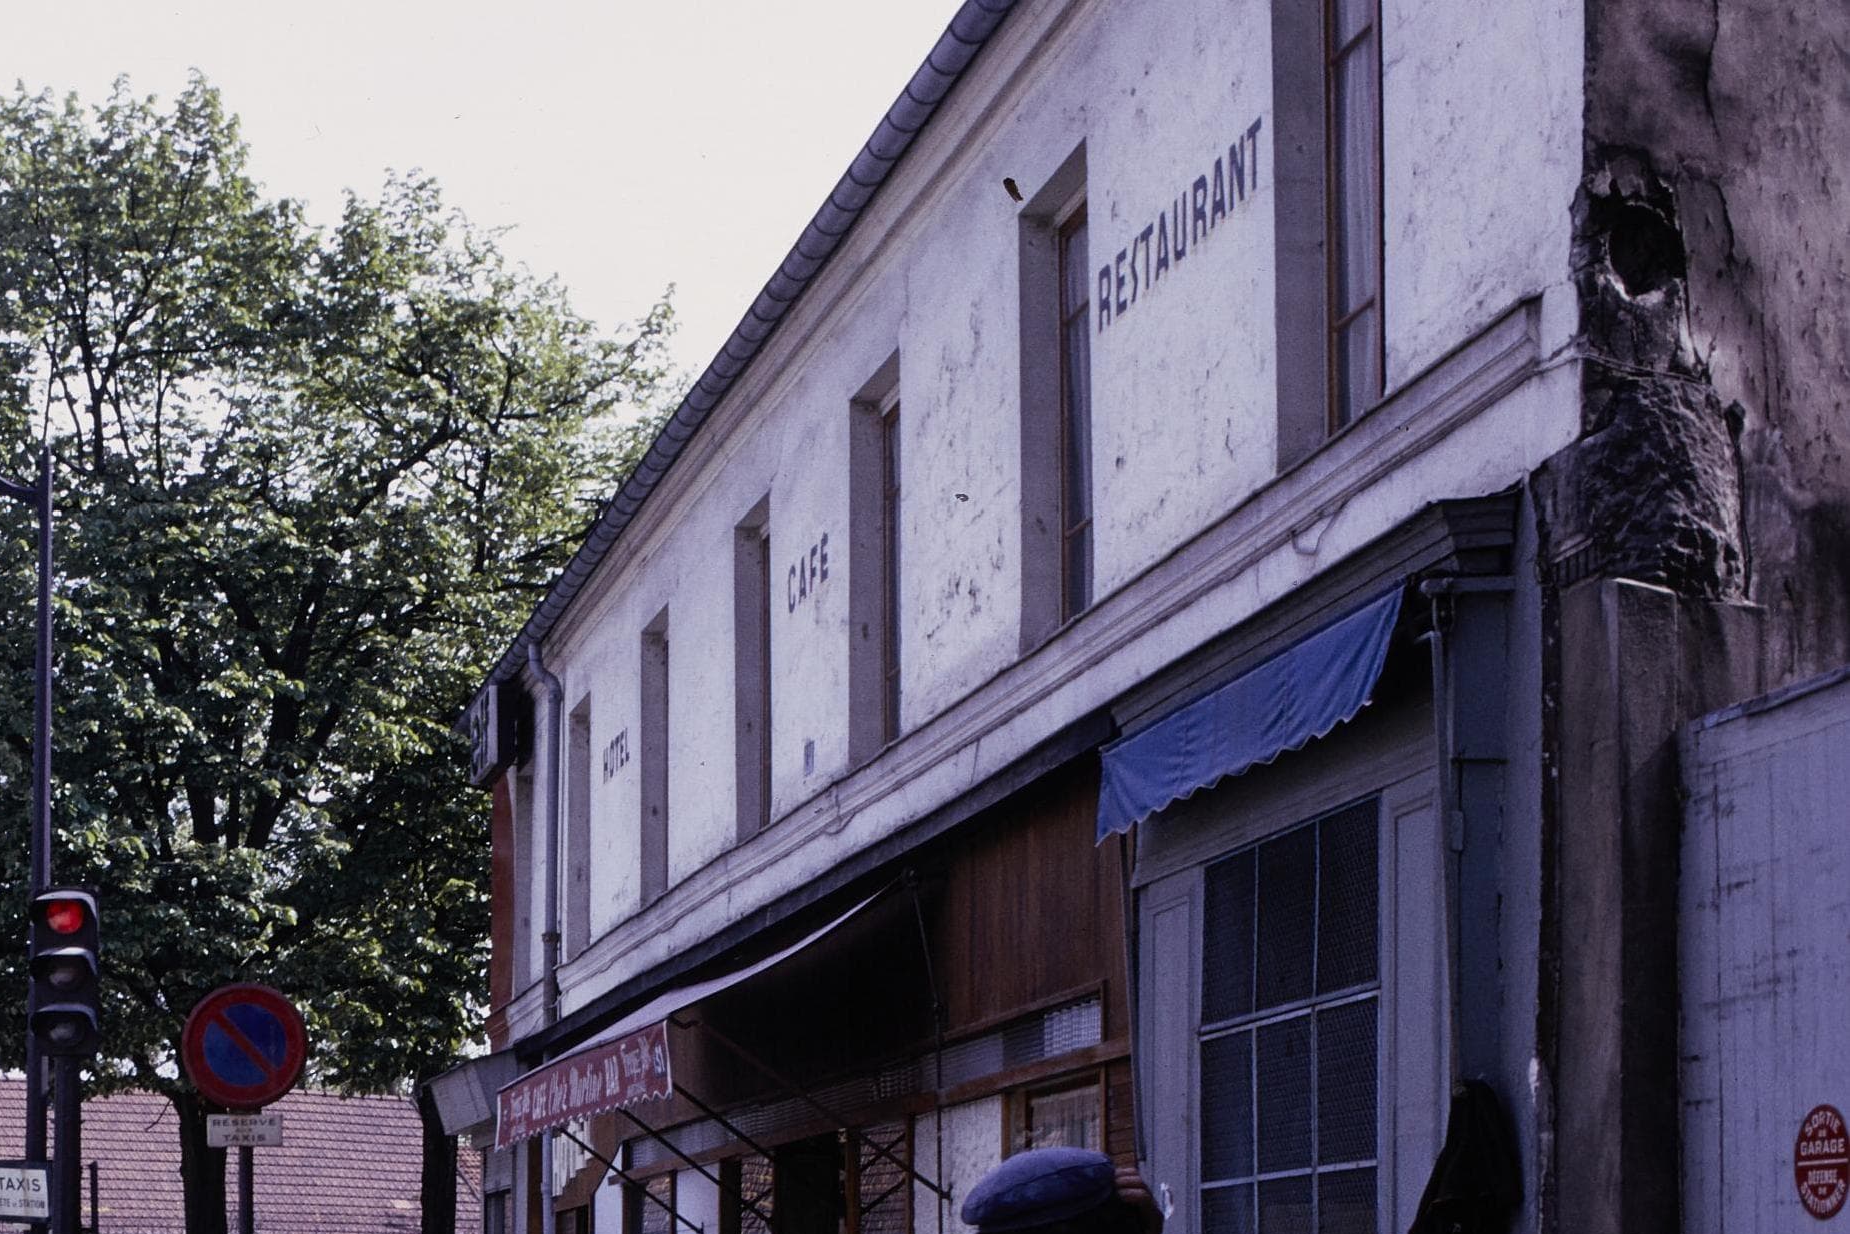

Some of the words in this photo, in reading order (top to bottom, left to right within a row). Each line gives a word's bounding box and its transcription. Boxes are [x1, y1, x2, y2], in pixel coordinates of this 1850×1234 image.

[1098, 115, 1262, 334] RESTAURANT
[602, 727, 630, 785] HOTEL
[222, 1134, 266, 1142] TAXIS
[1804, 1110, 1841, 1137] SORTIE
[1800, 1138, 1845, 1157] GARAGE
[1800, 1178, 1846, 1214] STATIONNER
